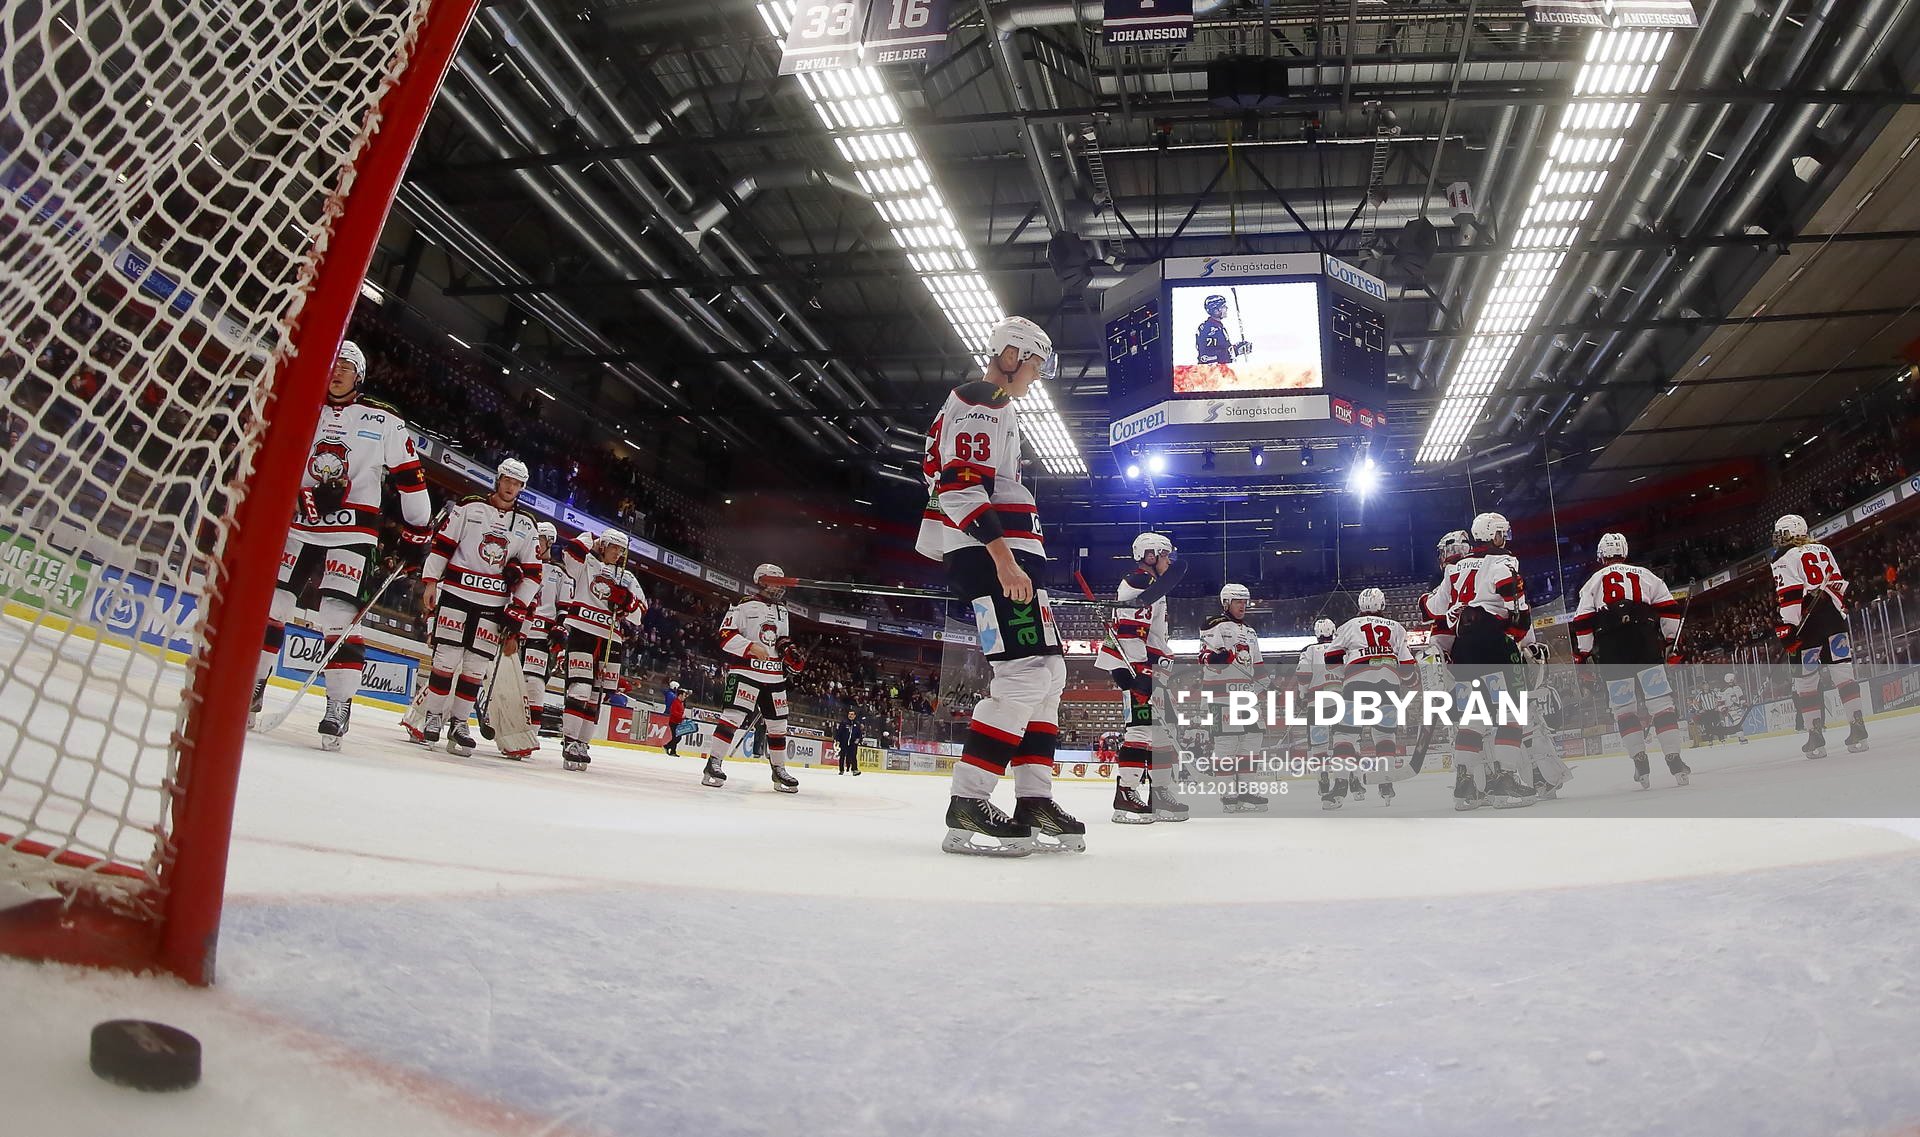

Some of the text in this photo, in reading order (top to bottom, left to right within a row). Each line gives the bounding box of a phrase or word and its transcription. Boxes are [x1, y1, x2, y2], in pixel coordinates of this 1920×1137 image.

[802, 3, 854, 38] 33
[888, 0, 930, 30] 16
[1534, 11, 1604, 25] JACOBSSON
[1623, 13, 1692, 25] ANDERSSON
[1109, 27, 1187, 42] JOHANSSON
[794, 56, 842, 71] EMVALL
[877, 48, 927, 63] HELBER
[1219, 260, 1289, 275] Stångåstaden
[1327, 259, 1386, 300] Corren
[1225, 403, 1298, 419] Stångåstaden
[1335, 404, 1352, 420] mix
[1111, 407, 1166, 443] Corren
[956, 432, 991, 462] 63
[1861, 497, 1887, 516] Corren
[326, 559, 362, 580] MAXI
[1602, 571, 1643, 604] 61
[615, 717, 668, 739] CM
[796, 745, 824, 758] SAAB
